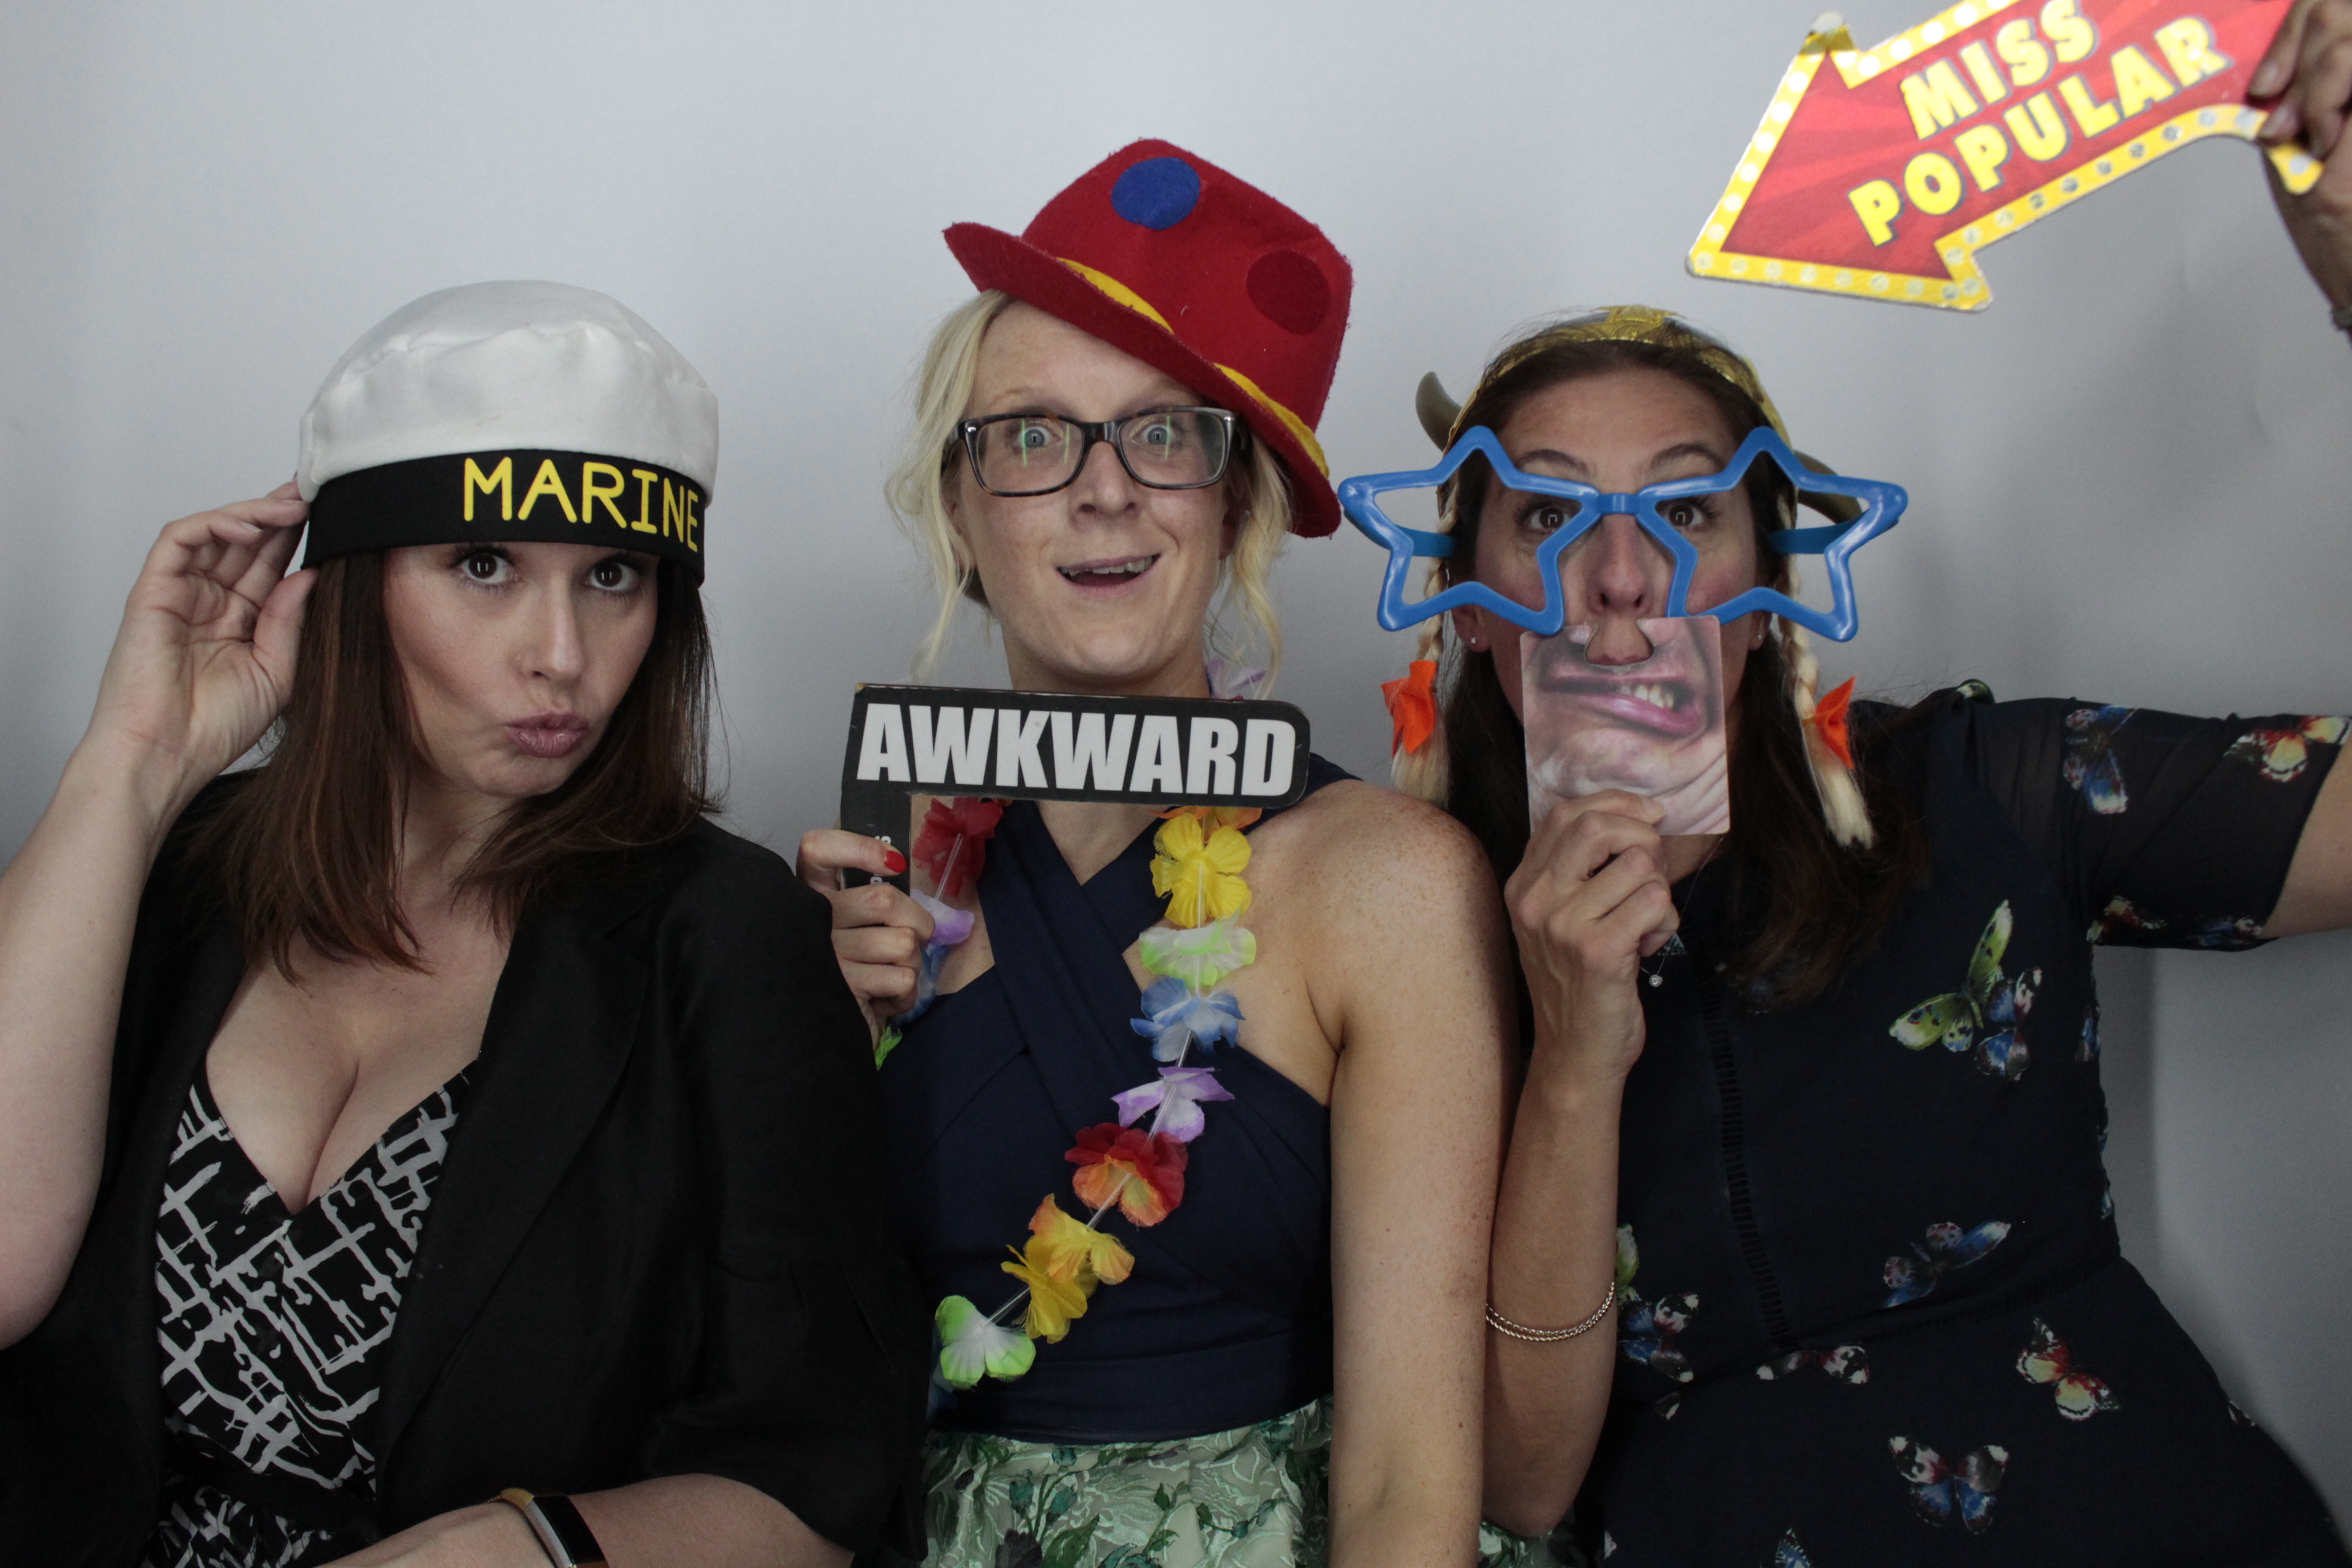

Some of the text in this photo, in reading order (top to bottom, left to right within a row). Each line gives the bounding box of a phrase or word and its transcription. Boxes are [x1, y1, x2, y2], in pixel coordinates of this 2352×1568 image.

[1899, 0, 2097, 140] MISS
[1848, 16, 2231, 246] POPULAR
[463, 457, 698, 553] MARINE
[857, 703, 1296, 796] AWKWARD
